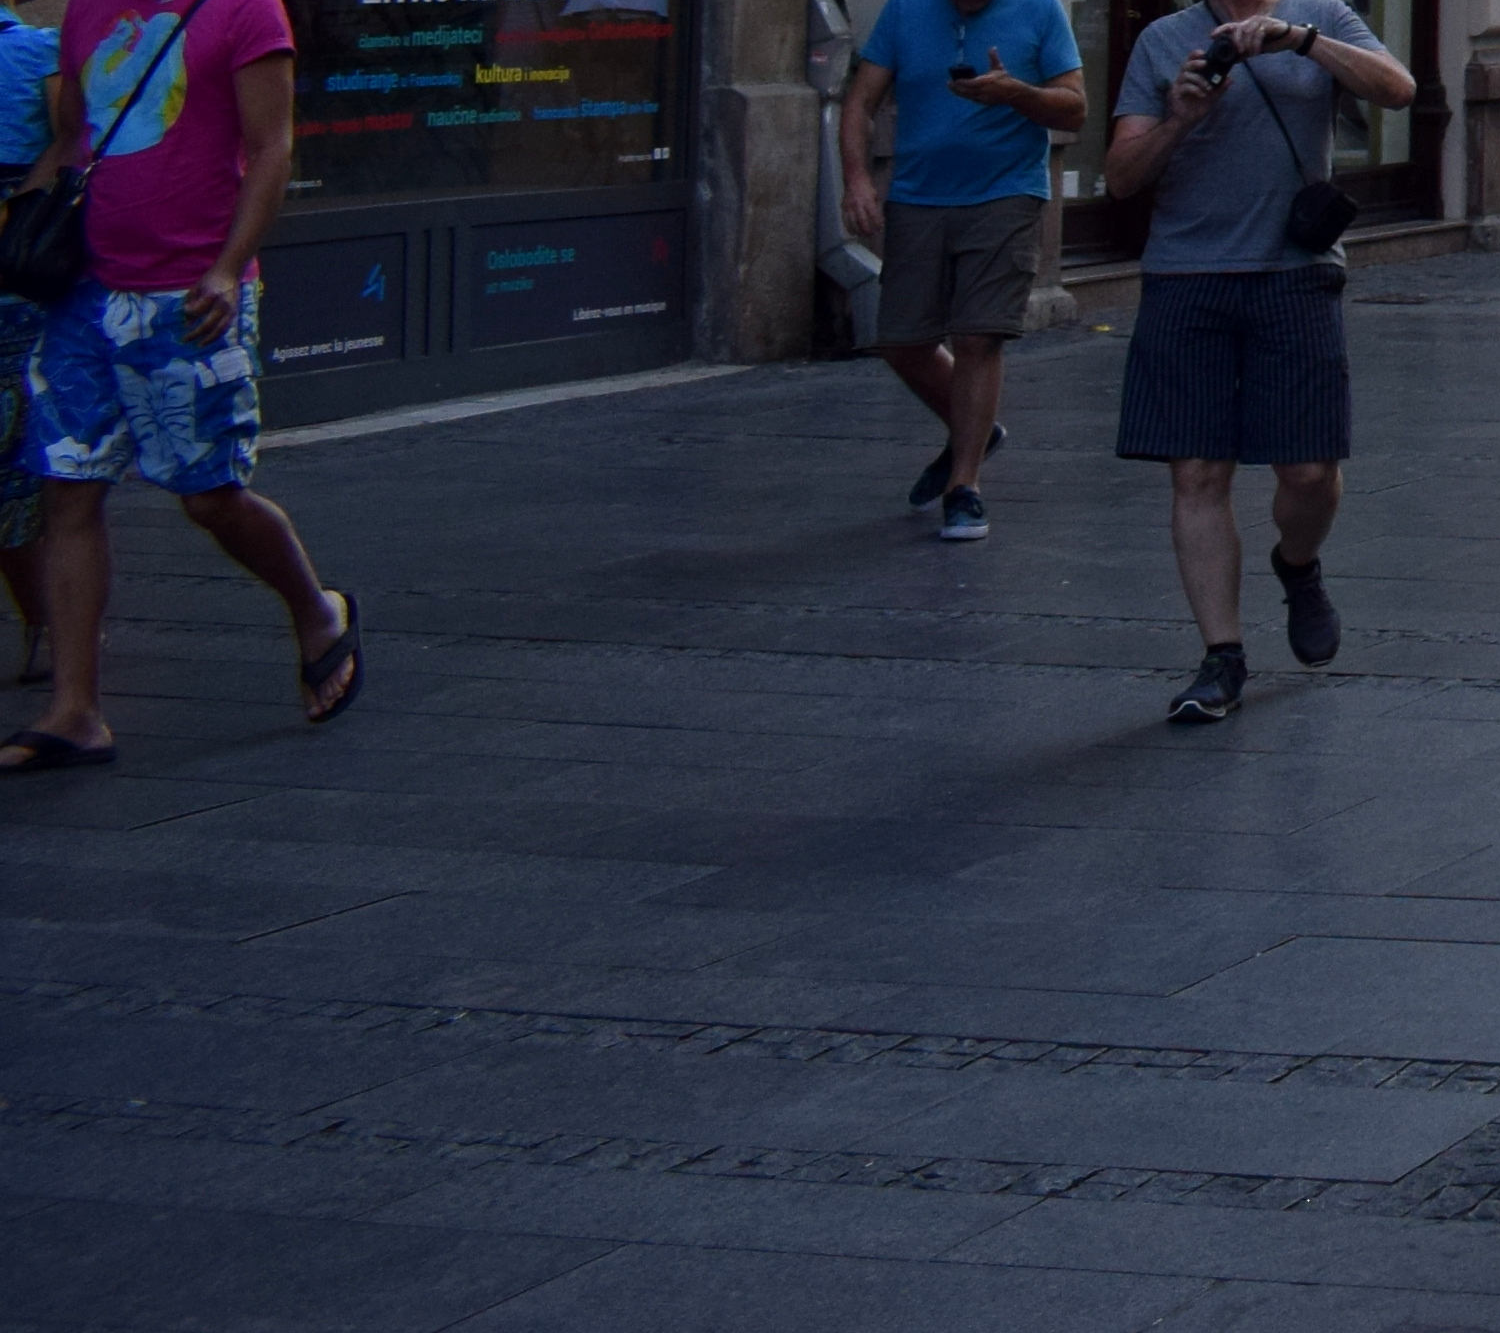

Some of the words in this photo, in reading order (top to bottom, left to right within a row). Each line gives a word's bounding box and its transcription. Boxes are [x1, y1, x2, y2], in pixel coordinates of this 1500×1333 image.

[474, 62, 523, 84] kultura
[270, 343, 310, 364] Agissez
[310, 341, 333, 358] avec
